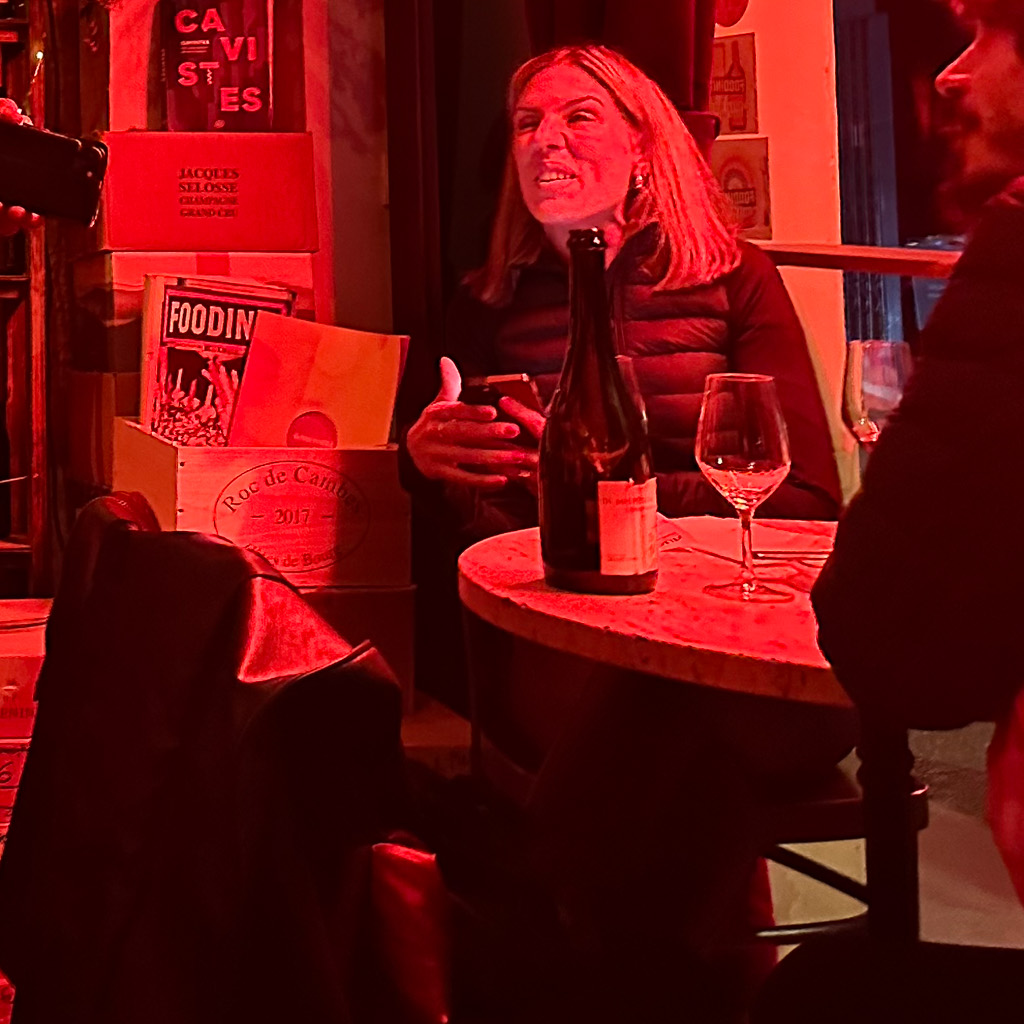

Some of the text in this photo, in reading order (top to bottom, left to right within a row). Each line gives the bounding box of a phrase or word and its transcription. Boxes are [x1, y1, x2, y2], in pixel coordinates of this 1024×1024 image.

[178, 167, 240, 180] JACQUES
[178, 182, 238, 193] SELOSSE
[178, 195, 239, 205] CHAMPAGNE
[179, 208, 238, 217] GRAND CRU
[169, 300, 255, 341] FOODIN
[222, 466, 362, 515] Roc de Cambes
[274, 508, 311, 525] 2017
